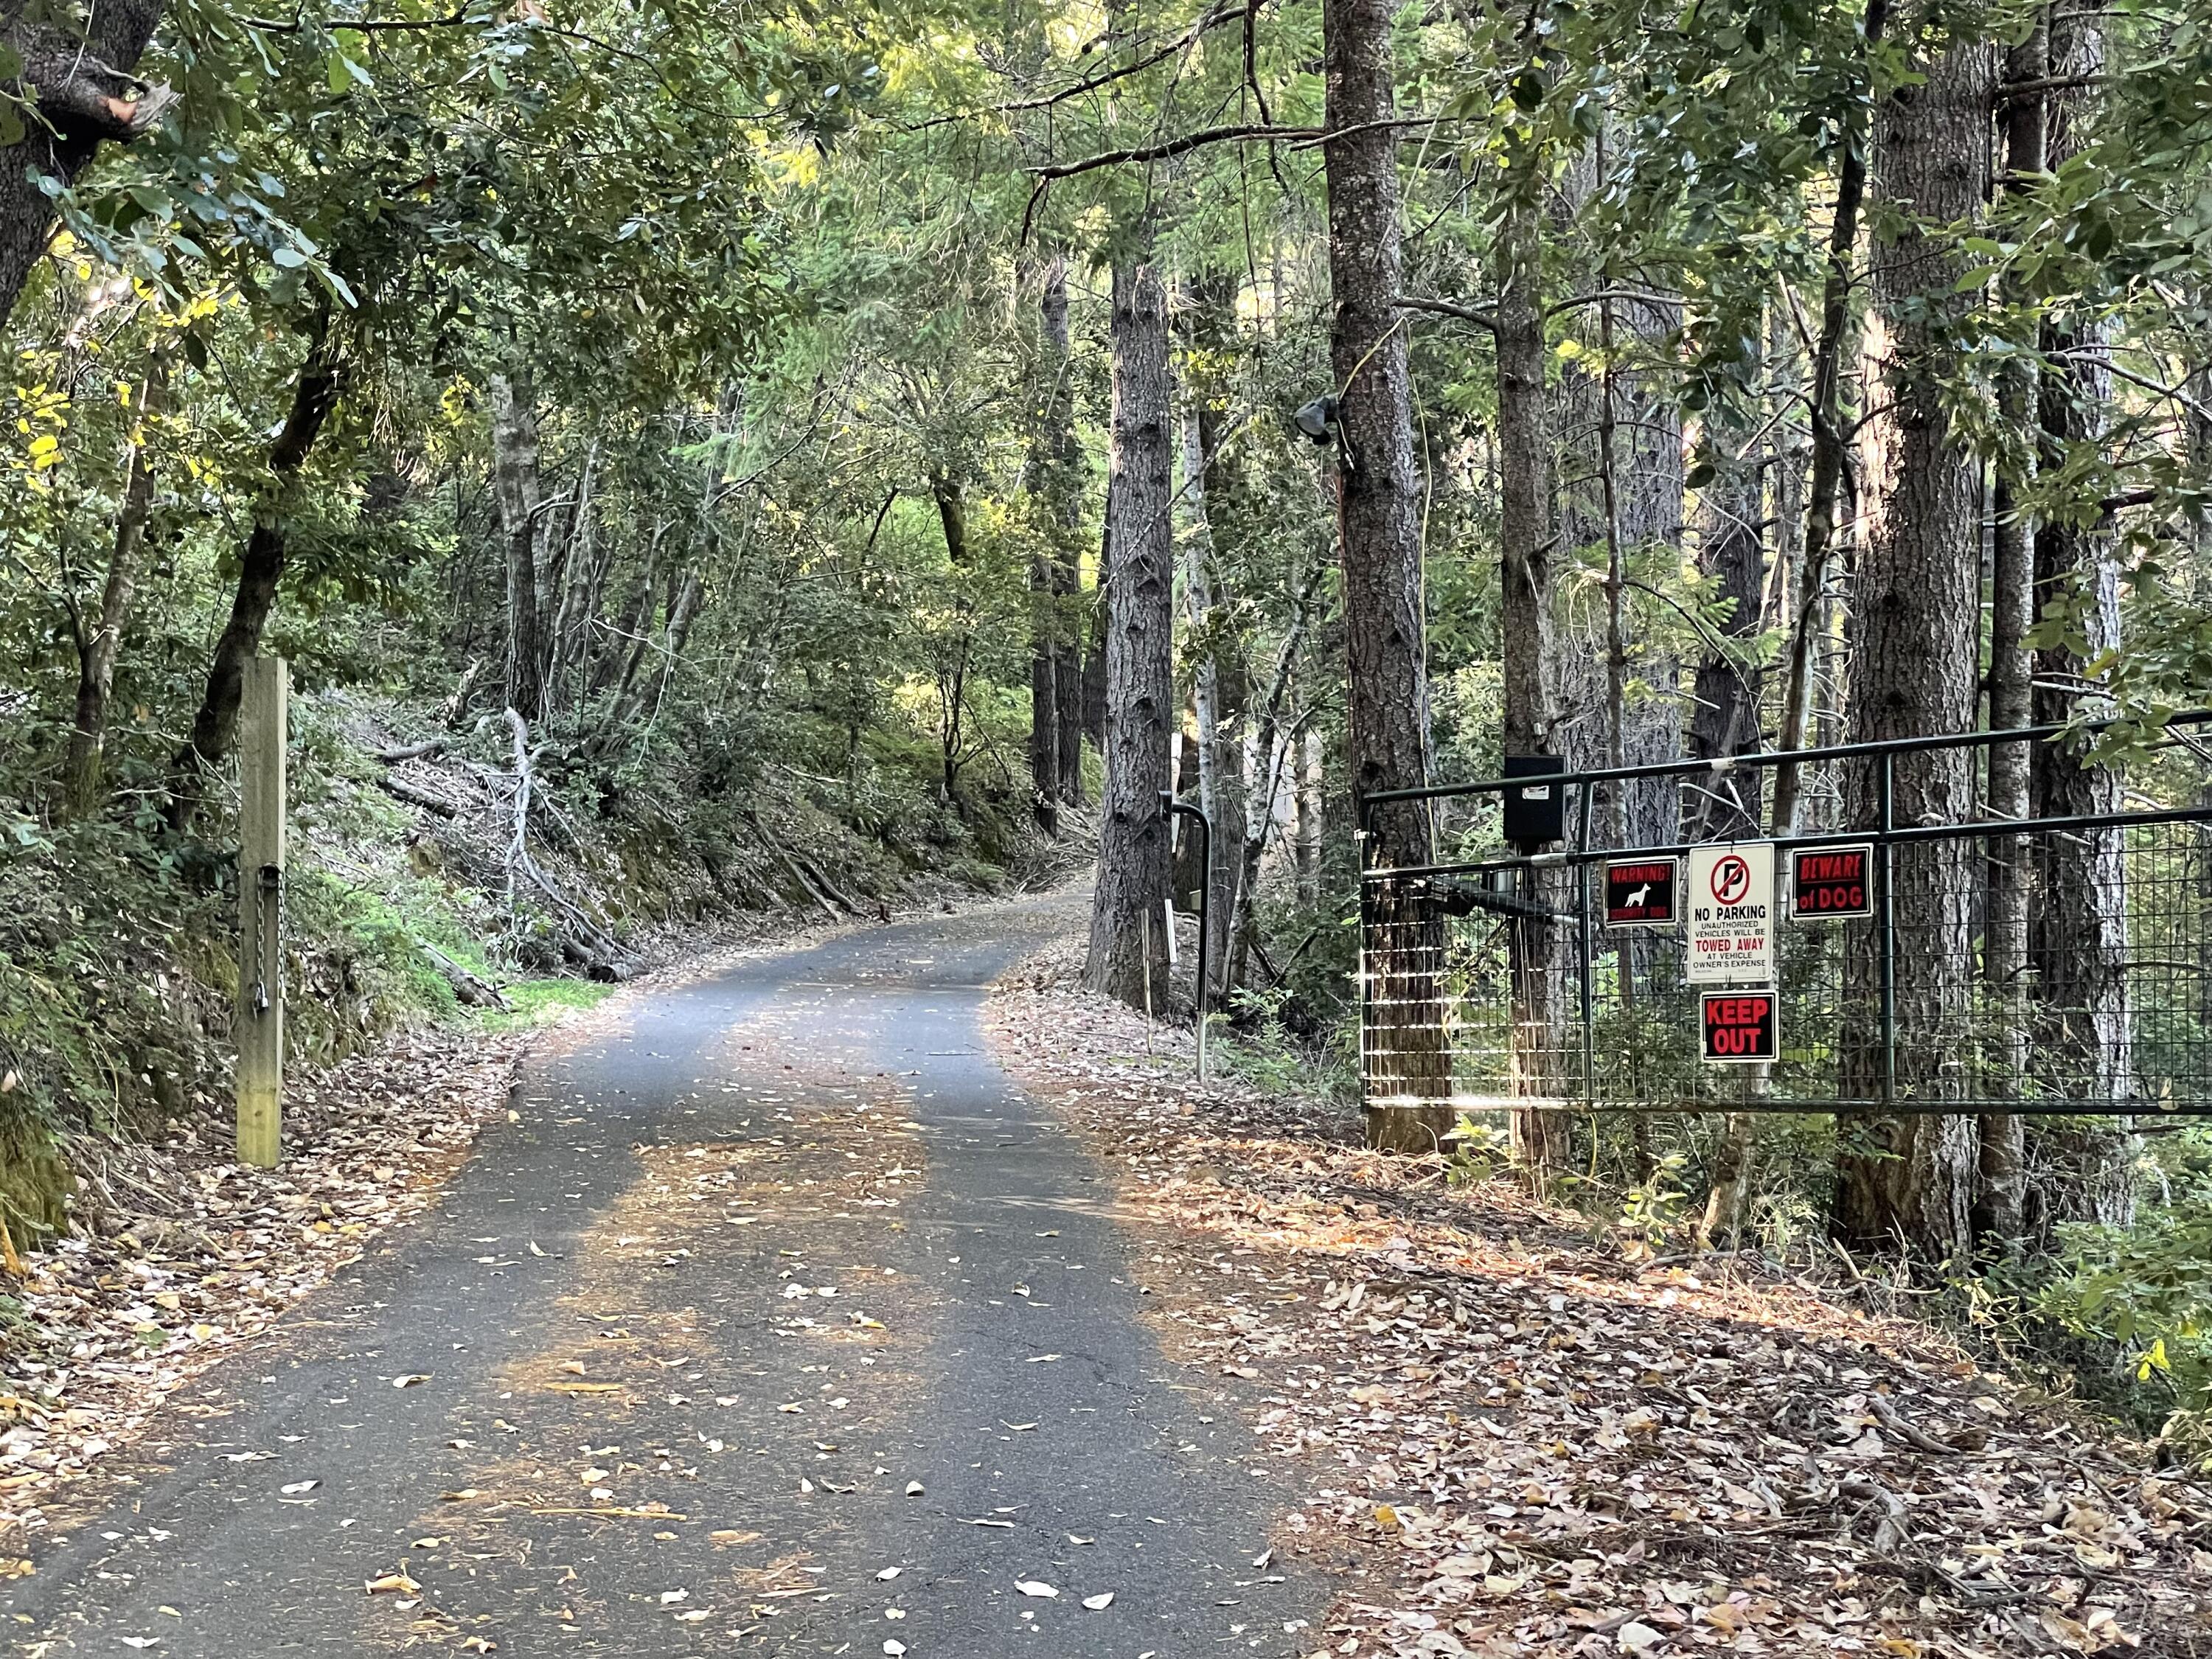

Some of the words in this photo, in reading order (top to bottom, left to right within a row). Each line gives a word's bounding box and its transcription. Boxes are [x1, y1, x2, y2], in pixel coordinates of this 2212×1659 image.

[1612, 865, 1670, 883] WARNING!
[1801, 855, 1862, 880] BEWARE
[1800, 889, 1815, 909] of
[1819, 886, 1863, 908] DOG
[1694, 908, 1710, 921] NO
[1717, 905, 1766, 920] PARKING
[1701, 921, 1759, 929] UNAUTHORIZED
[1696, 939, 1731, 953] TOWED
[1737, 938, 1764, 950] AWAY
[1707, 999, 1768, 1025] KEEP
[1714, 1028, 1761, 1054] OUT
